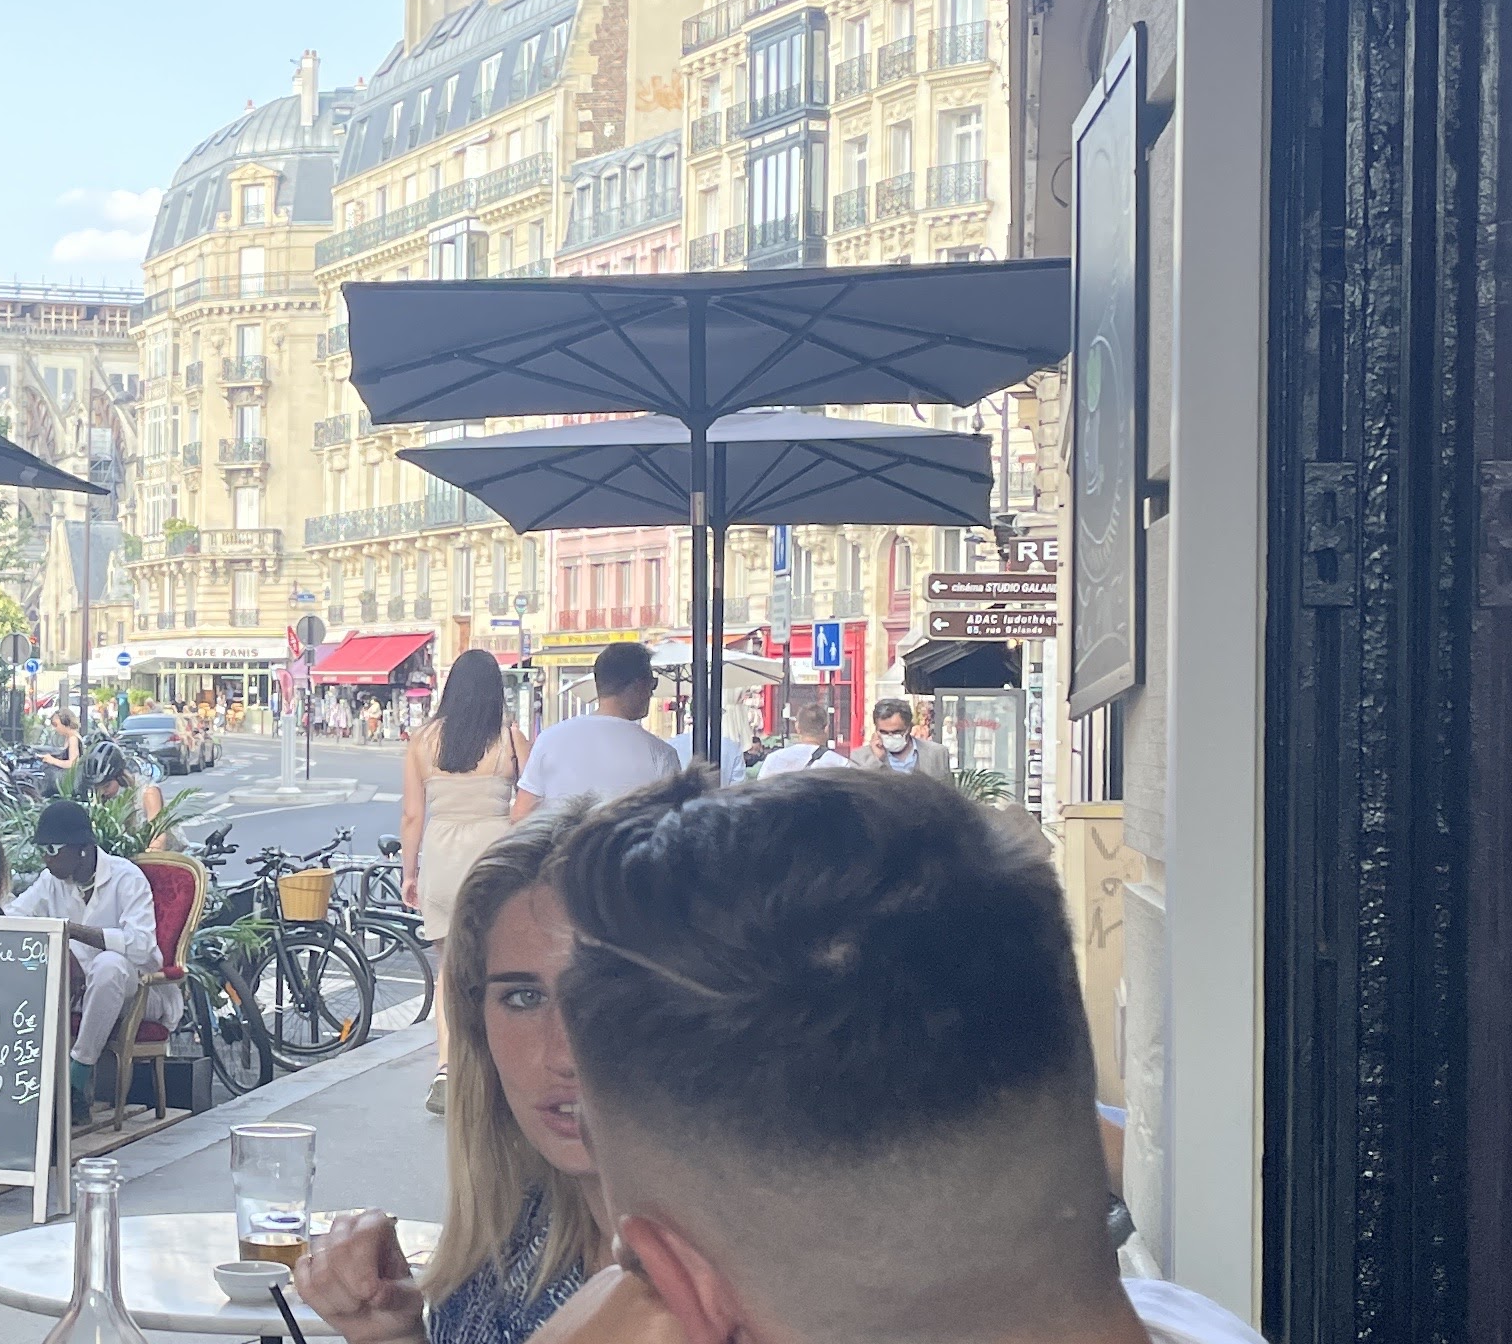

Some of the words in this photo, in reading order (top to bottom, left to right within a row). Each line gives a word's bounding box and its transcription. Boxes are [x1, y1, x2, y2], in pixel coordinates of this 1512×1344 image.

[951, 582, 985, 593] cinéma
[985, 582, 1021, 593] STUDIO
[966, 614, 998, 625] ADAC
[985, 626, 1001, 634] rue
[1005, 625, 1043, 634] Galande
[222, 648, 259, 658] PANIS
[13, 1000, 37, 1028] 6€
[11, 1070, 40, 1100] 5€
